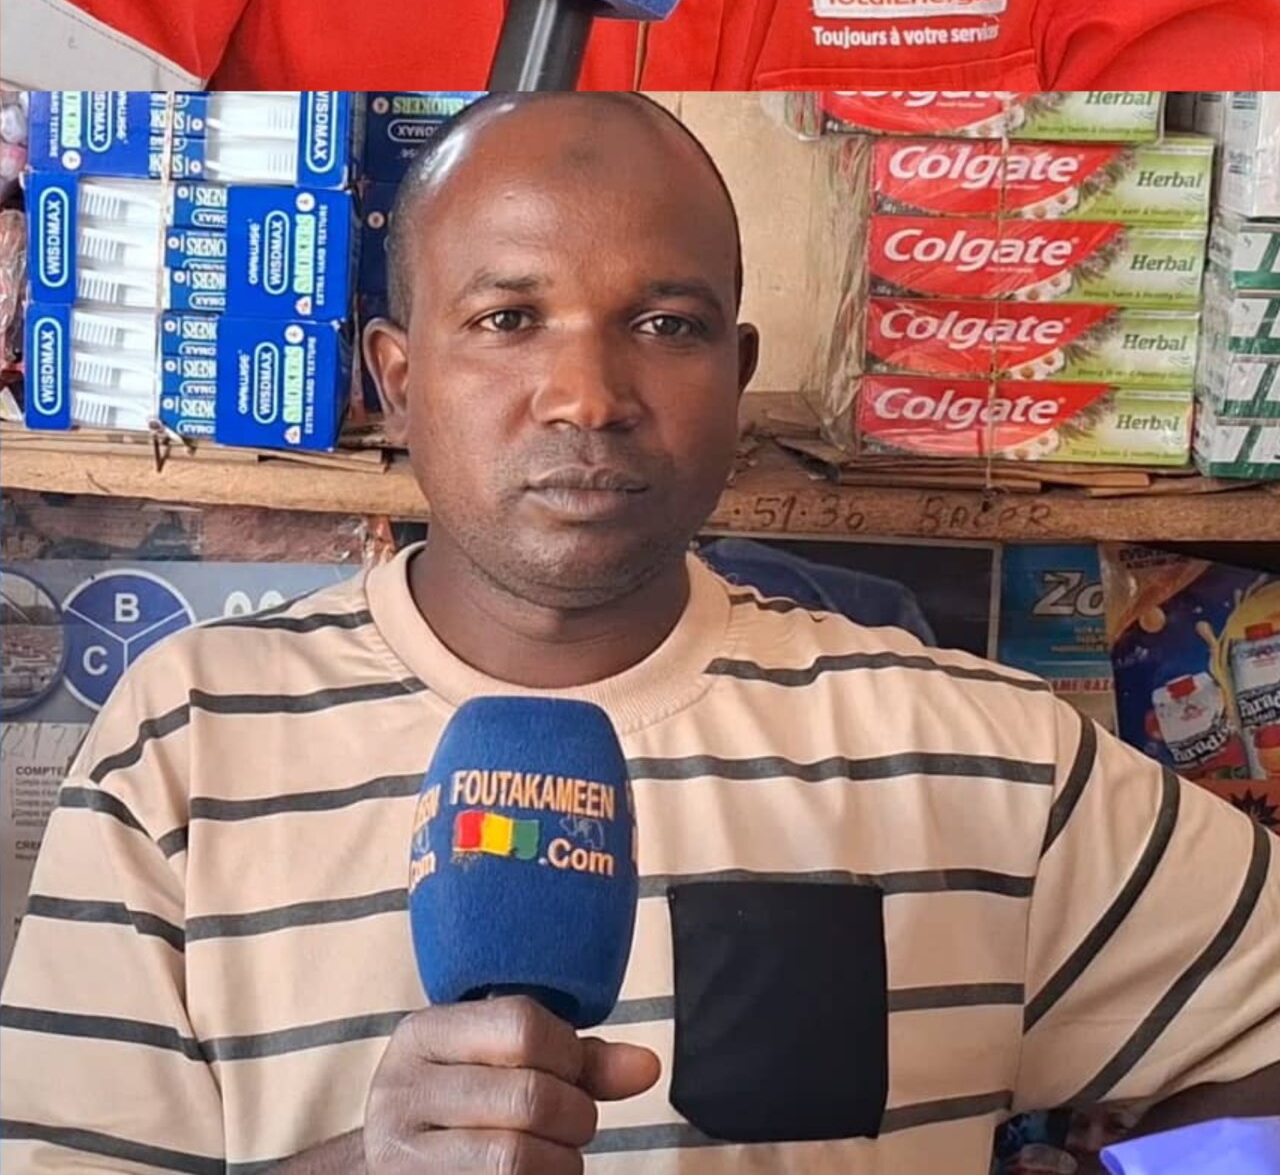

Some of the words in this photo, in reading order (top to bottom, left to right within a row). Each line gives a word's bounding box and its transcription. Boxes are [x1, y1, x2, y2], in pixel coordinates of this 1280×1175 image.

[811, 26, 888, 49] Toujours
[890, 26, 901, 45] à
[903, 26, 948, 45] votre
[888, 145, 1080, 189] Colgate
[1136, 170, 1204, 189] Herbal
[47, 199, 62, 276] WISDMAX
[269, 219, 284, 286] WISDMAX
[883, 228, 1073, 272] Colgate
[1129, 254, 1196, 273] Herbal
[878, 308, 1066, 350] Colgate
[1121, 333, 1188, 353] Herbal
[41, 329, 55, 404] WISDMAX
[259, 350, 273, 416] WISDMAX
[872, 387, 1060, 430] Colgate
[1115, 413, 1180, 432] Herbal
[114, 593, 140, 623] B
[82, 646, 109, 675] C
[449, 769, 616, 821] FOUTAKAMEEN
[537, 837, 614, 877] .Com
